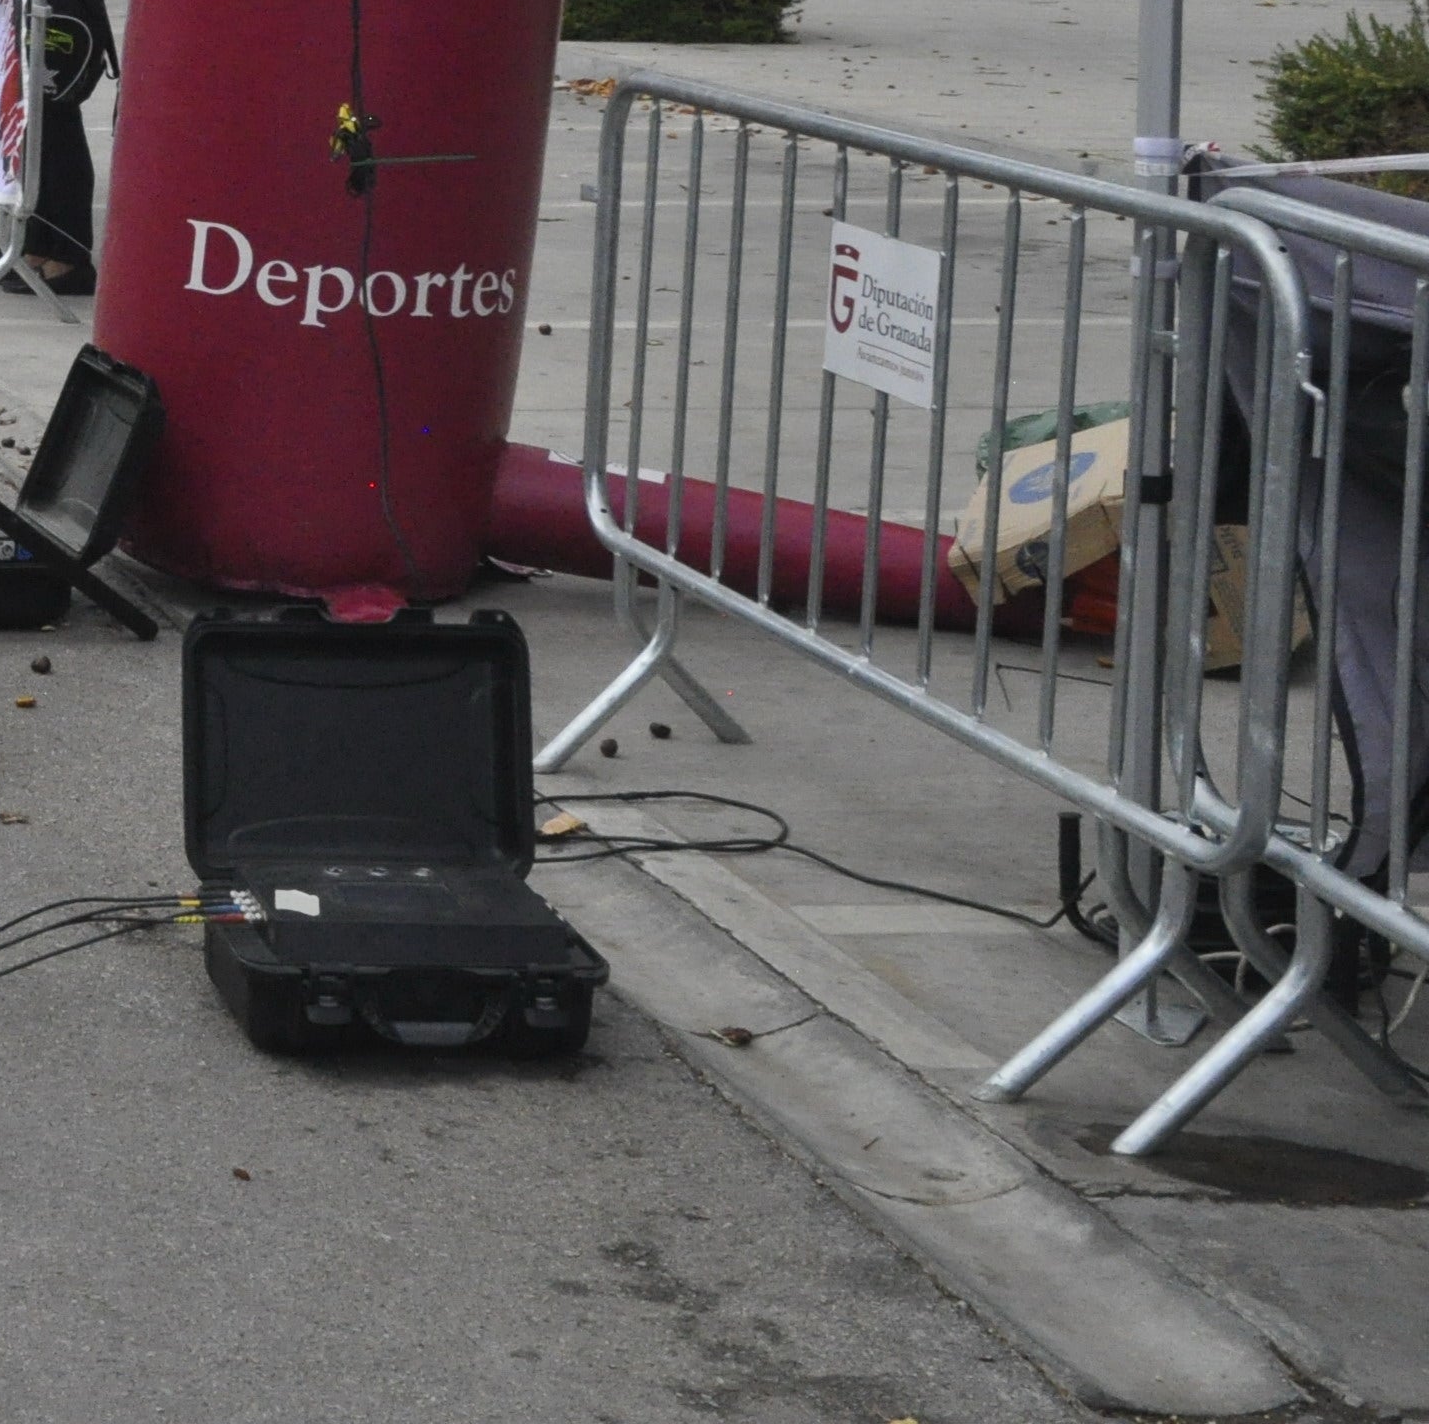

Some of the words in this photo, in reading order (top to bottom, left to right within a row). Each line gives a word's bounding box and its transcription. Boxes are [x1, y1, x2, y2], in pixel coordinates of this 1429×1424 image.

[184, 218, 517, 328] Deportes
[861, 273, 933, 321] Diputación
[858, 305, 876, 332] de
[876, 312, 932, 354] Granada
